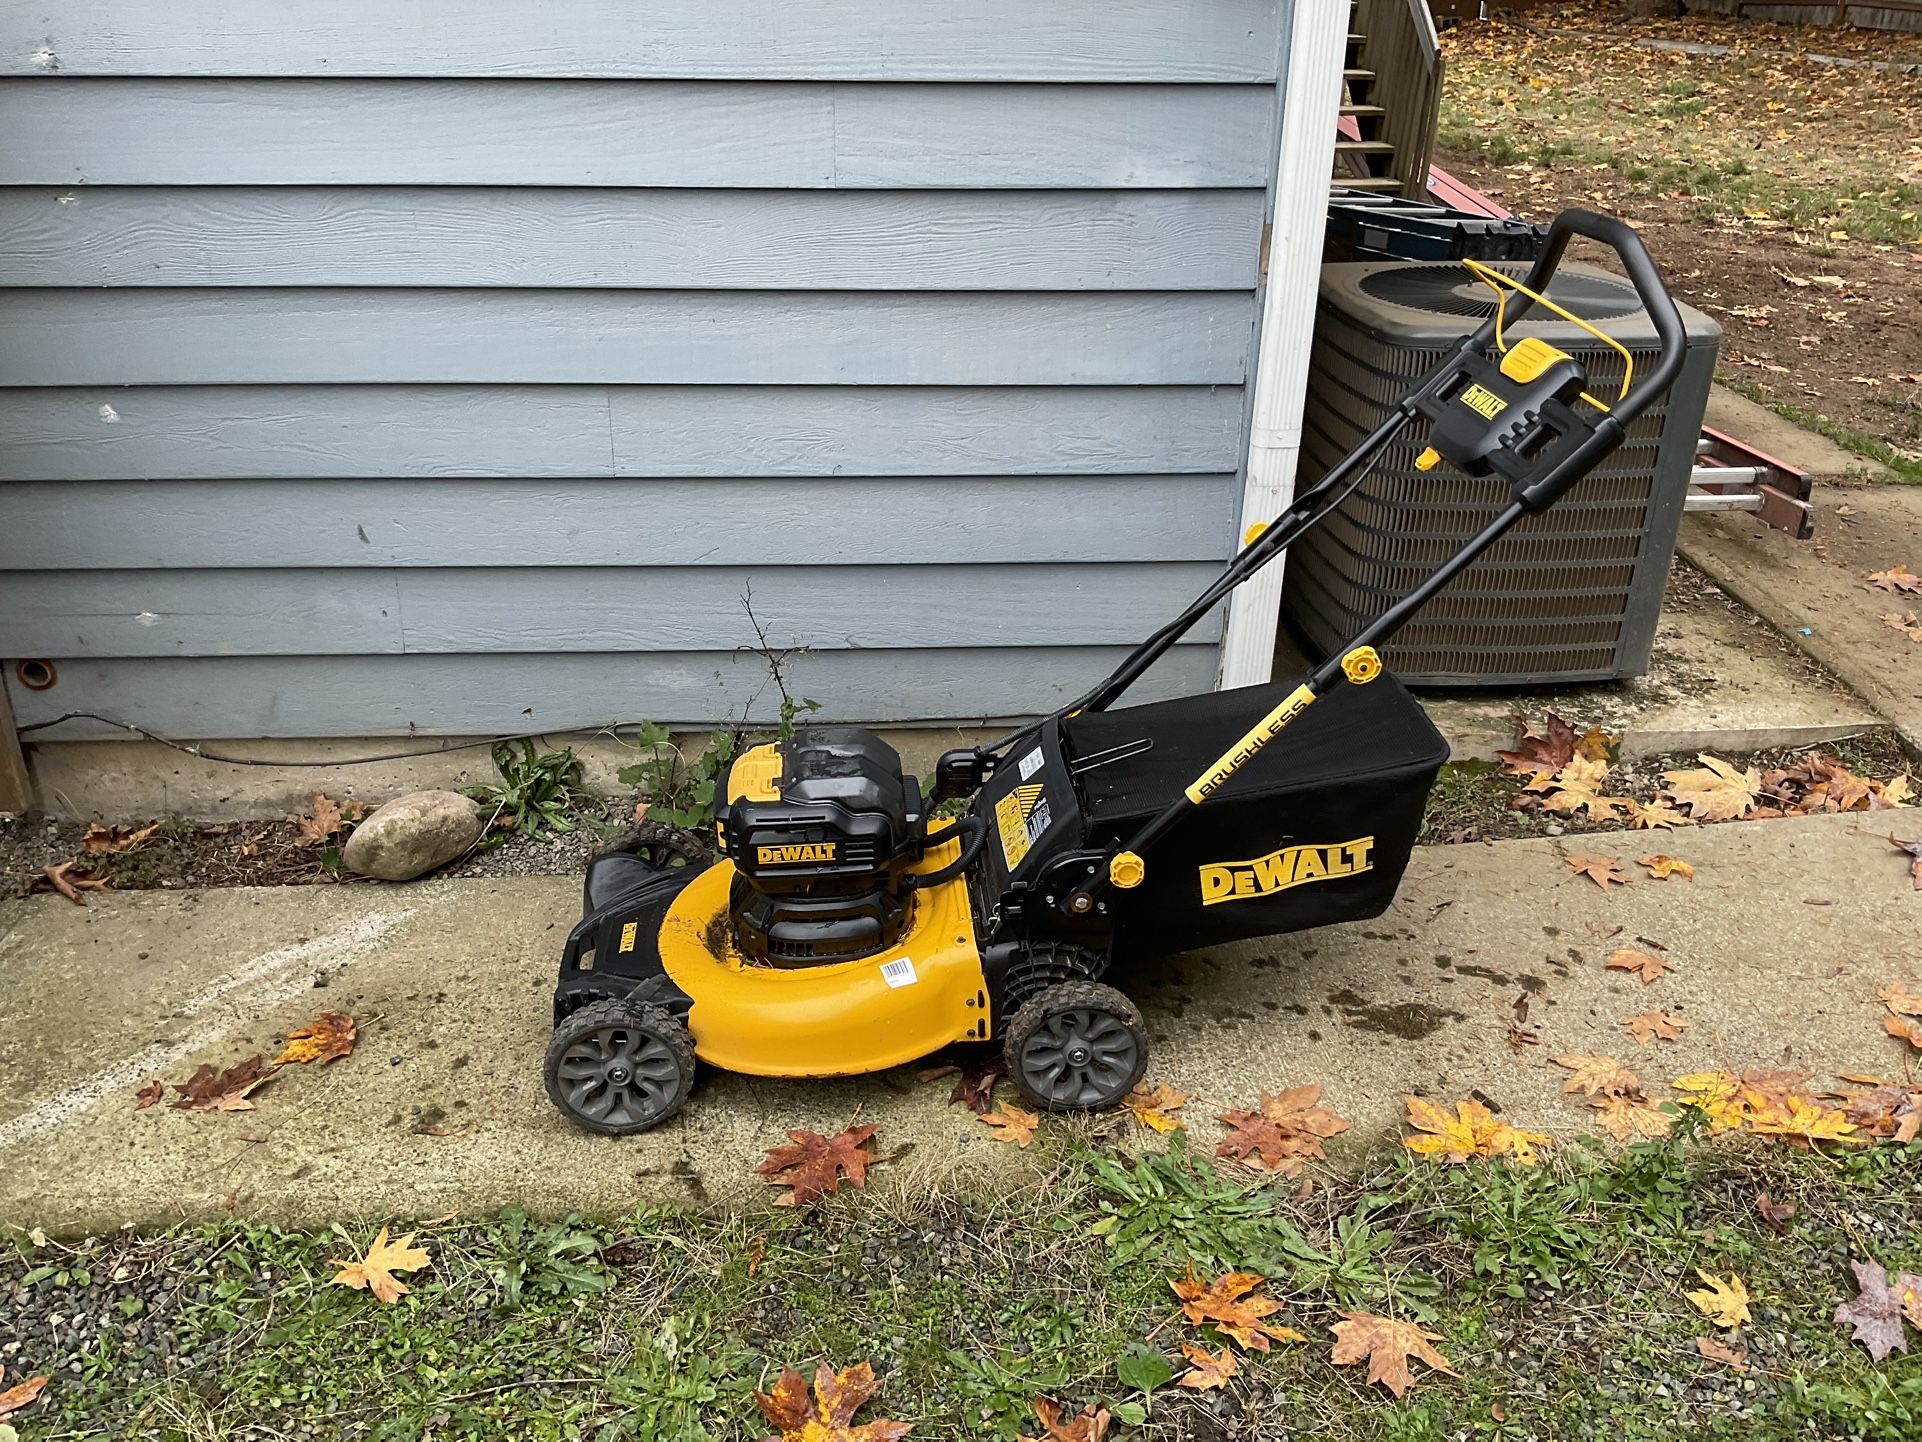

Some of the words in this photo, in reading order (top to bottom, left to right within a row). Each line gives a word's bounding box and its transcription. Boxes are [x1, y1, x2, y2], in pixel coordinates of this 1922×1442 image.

[1199, 699, 1308, 797] BRUSHLESS
[757, 843, 836, 863] DEWALT
[1200, 837, 1374, 904] DEWALT
